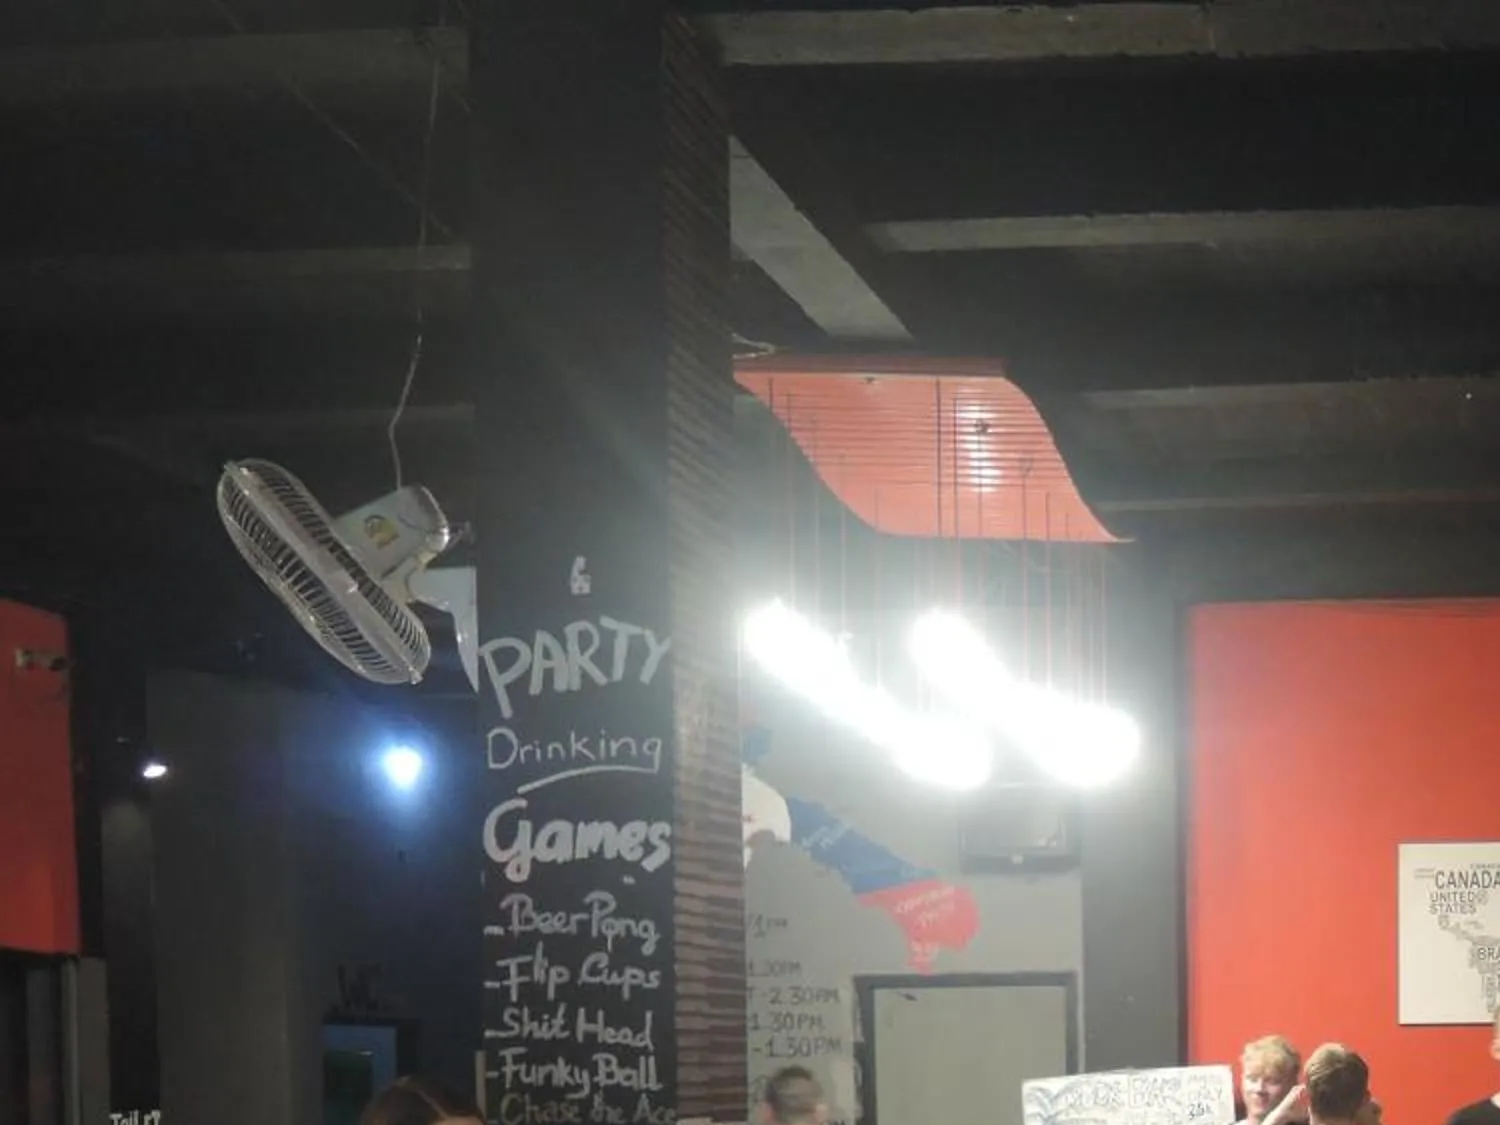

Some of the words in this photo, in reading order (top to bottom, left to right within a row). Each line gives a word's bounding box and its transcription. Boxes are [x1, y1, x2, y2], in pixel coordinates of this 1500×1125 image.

[480, 614, 671, 720] PARTY
[486, 725, 662, 777] Drinking
[482, 797, 672, 883] Games
[1430, 890, 1475, 903] UNITED
[584, 890, 661, 955] Pong
[579, 951, 661, 1001] Cups
[576, 1006, 655, 1051] Head
[592, 1052, 664, 1092] Ball
